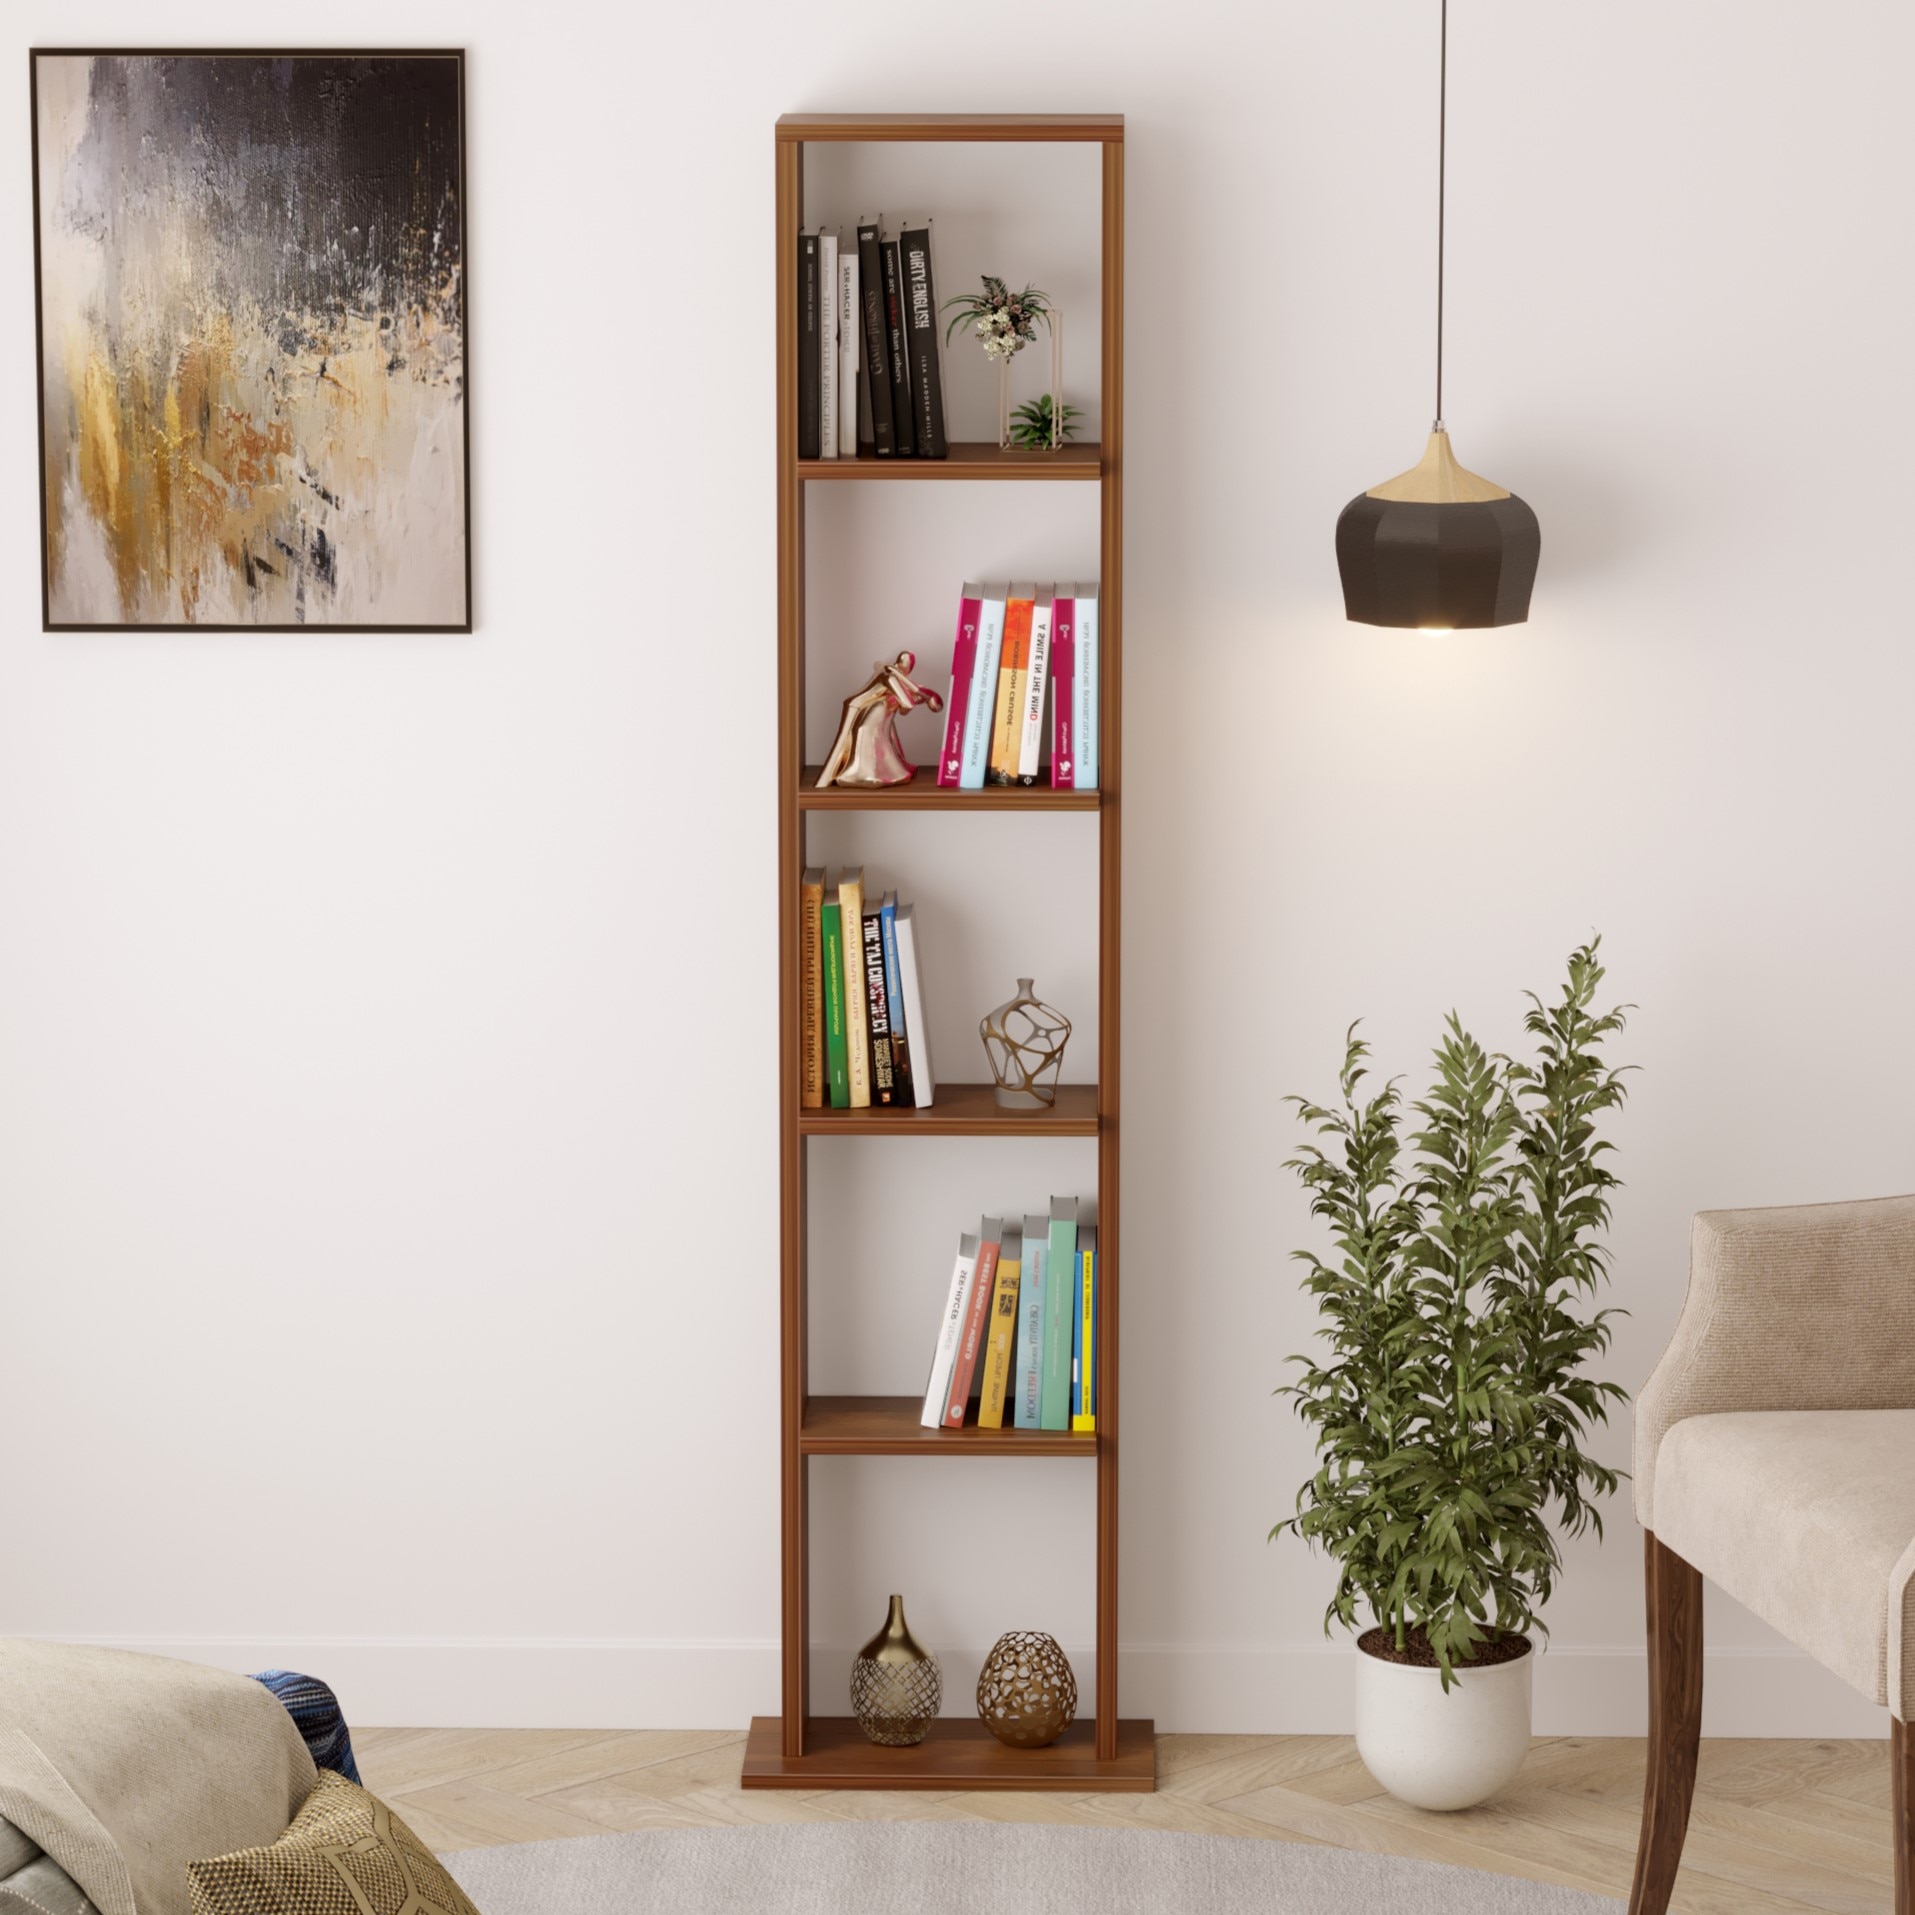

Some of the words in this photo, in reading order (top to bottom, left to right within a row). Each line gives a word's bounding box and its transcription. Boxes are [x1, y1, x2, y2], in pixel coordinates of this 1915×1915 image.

[909, 250, 926, 282] DIRTY
[912, 283, 930, 329] ENGLISH
[823, 324, 831, 372] PORTER
[892, 328, 901, 350] than
[894, 353, 902, 383] others
[823, 375, 831, 446] PRINCIPLES
[922, 377, 932, 439] MADDEN-MILLS
[806, 925, 816, 975] ГРЕЦИИ
[863, 918, 880, 943] THE
[865, 944, 882, 966] TAJ
[805, 977, 816, 1032] ДРЕВНЕЙ
[867, 968, 888, 1033] CONSPIRACY
[806, 1034, 816, 1093] ИСТОРИЯ
